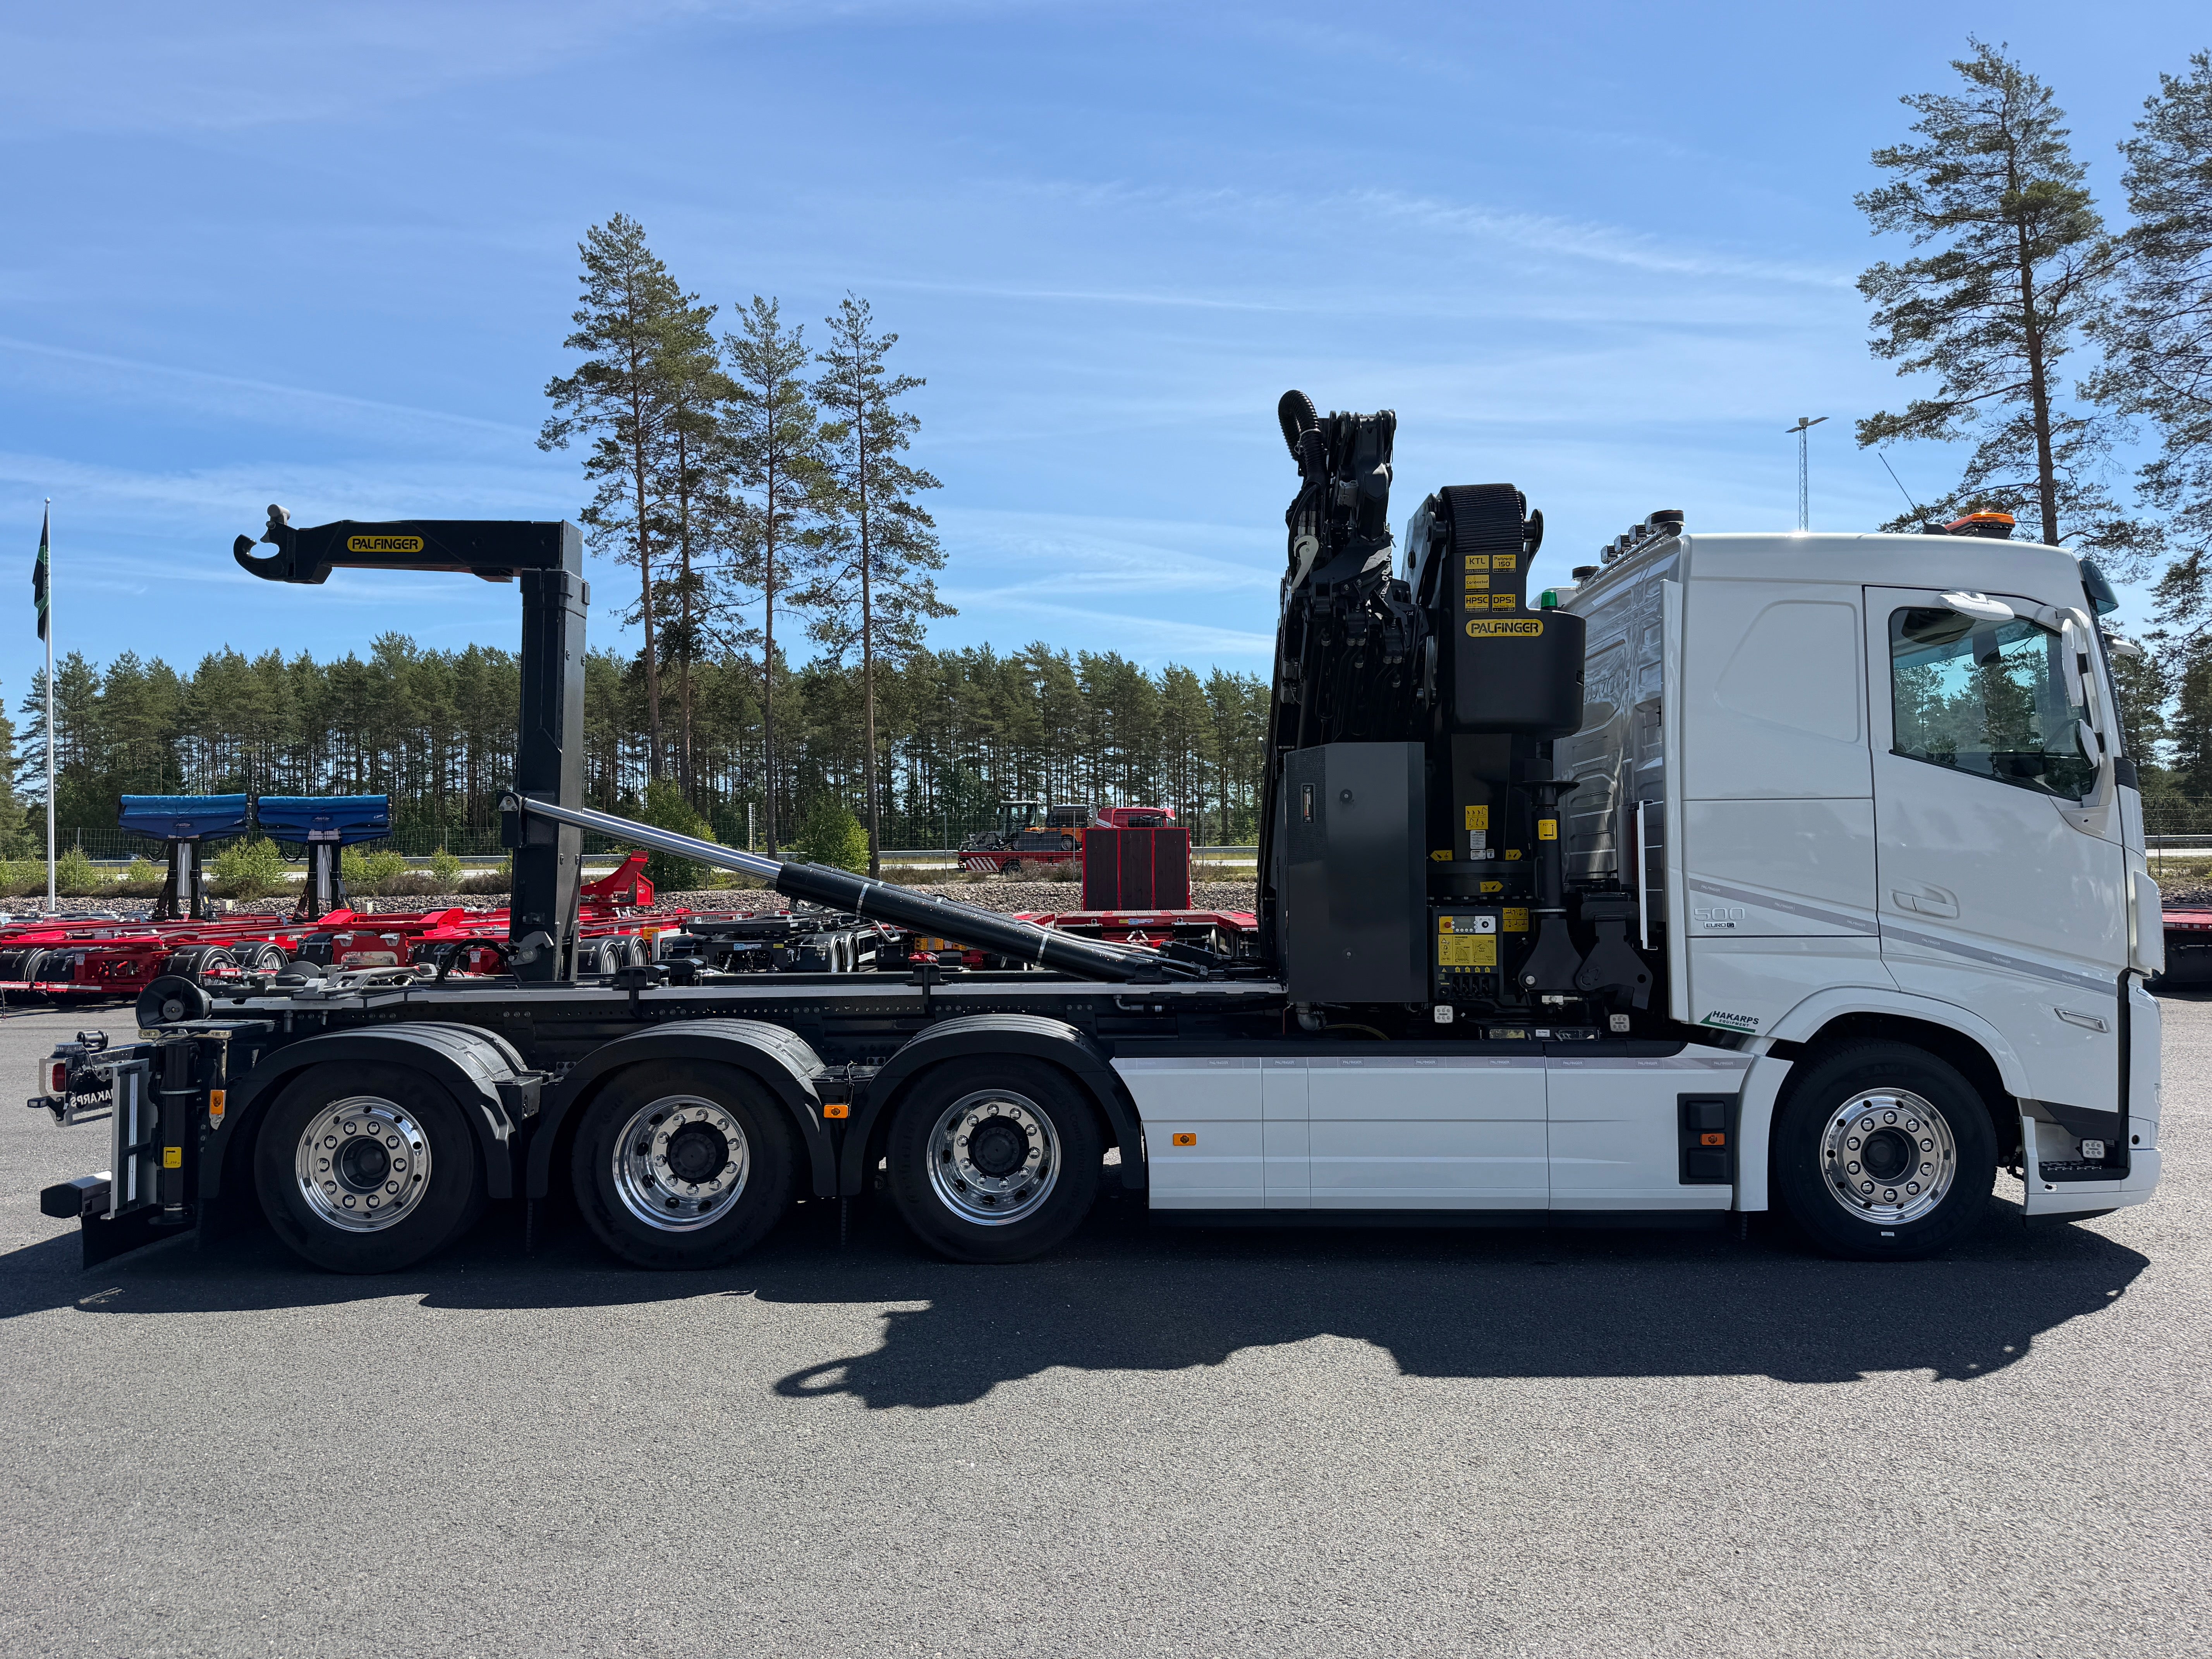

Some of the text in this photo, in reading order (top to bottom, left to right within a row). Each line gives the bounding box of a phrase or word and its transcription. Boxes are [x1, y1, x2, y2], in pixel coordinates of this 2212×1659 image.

[352, 539, 418, 549] PALFINGER
[1471, 623, 1539, 634] PALFINGER
[1694, 908, 1745, 921] 500
[1712, 1011, 1759, 1025] HAKARPS
